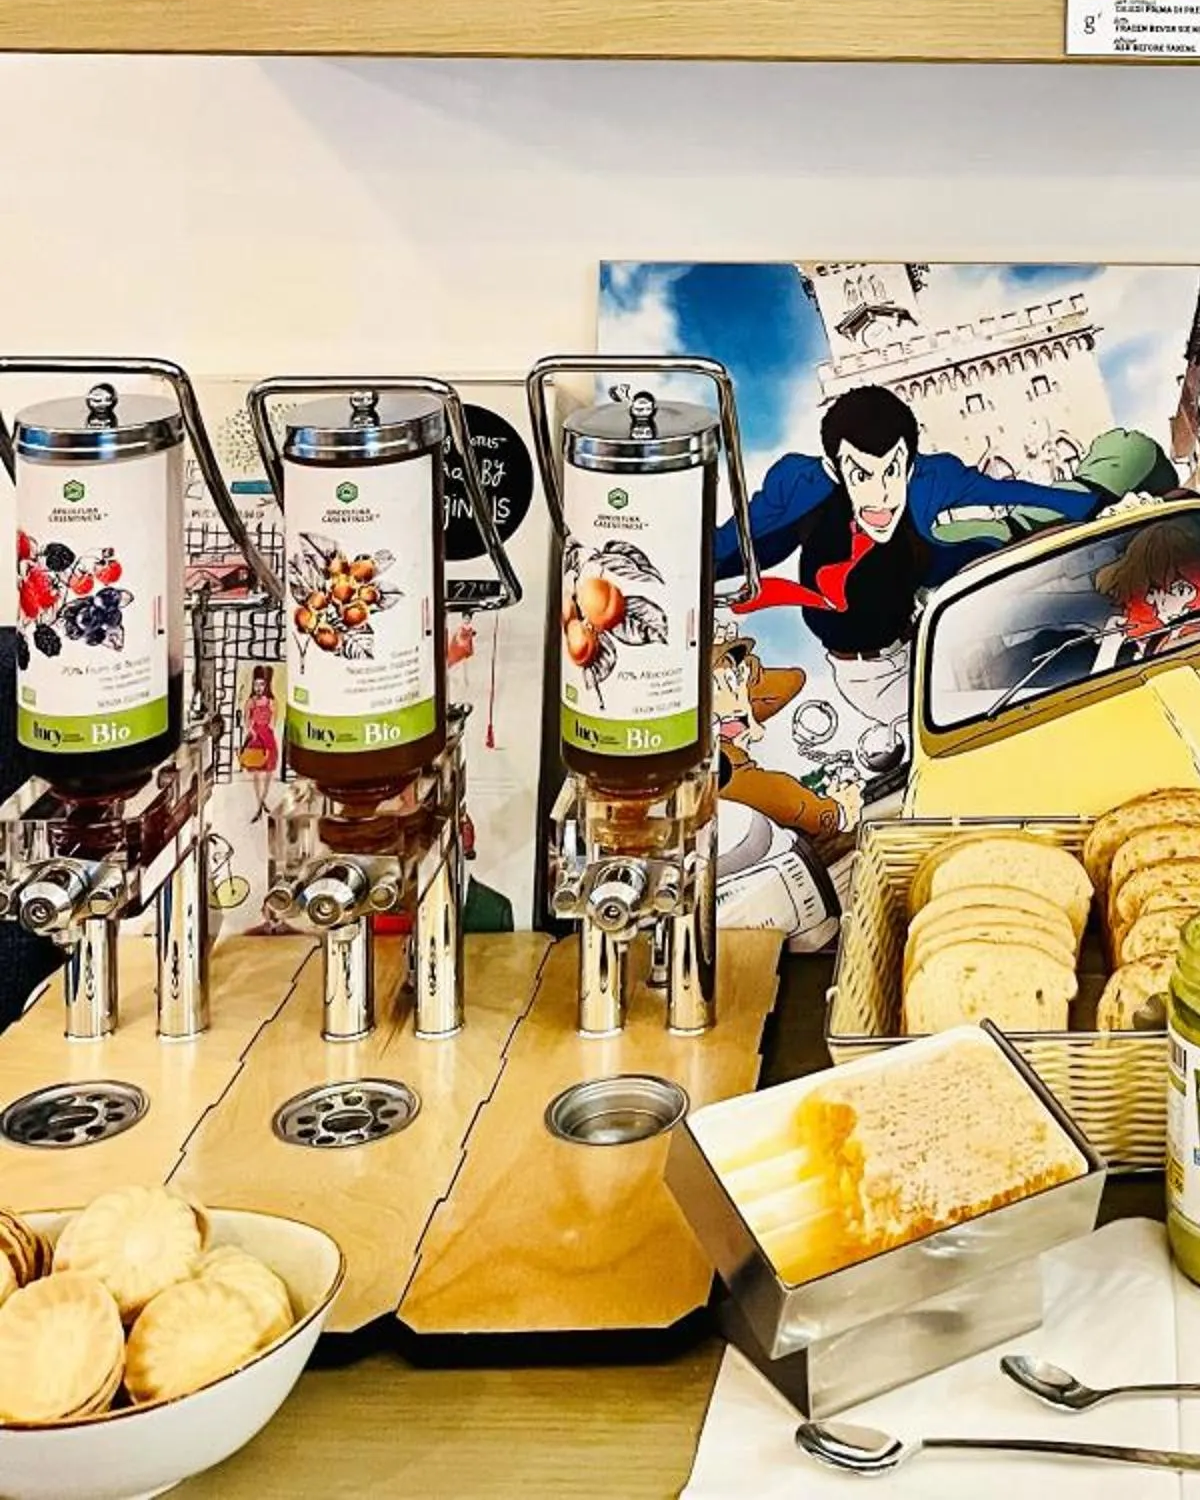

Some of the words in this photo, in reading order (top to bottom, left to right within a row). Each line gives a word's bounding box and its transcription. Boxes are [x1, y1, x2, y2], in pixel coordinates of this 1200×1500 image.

[90, 722, 132, 745] Bio
[363, 722, 402, 746] Bio
[625, 727, 663, 750] Bio
